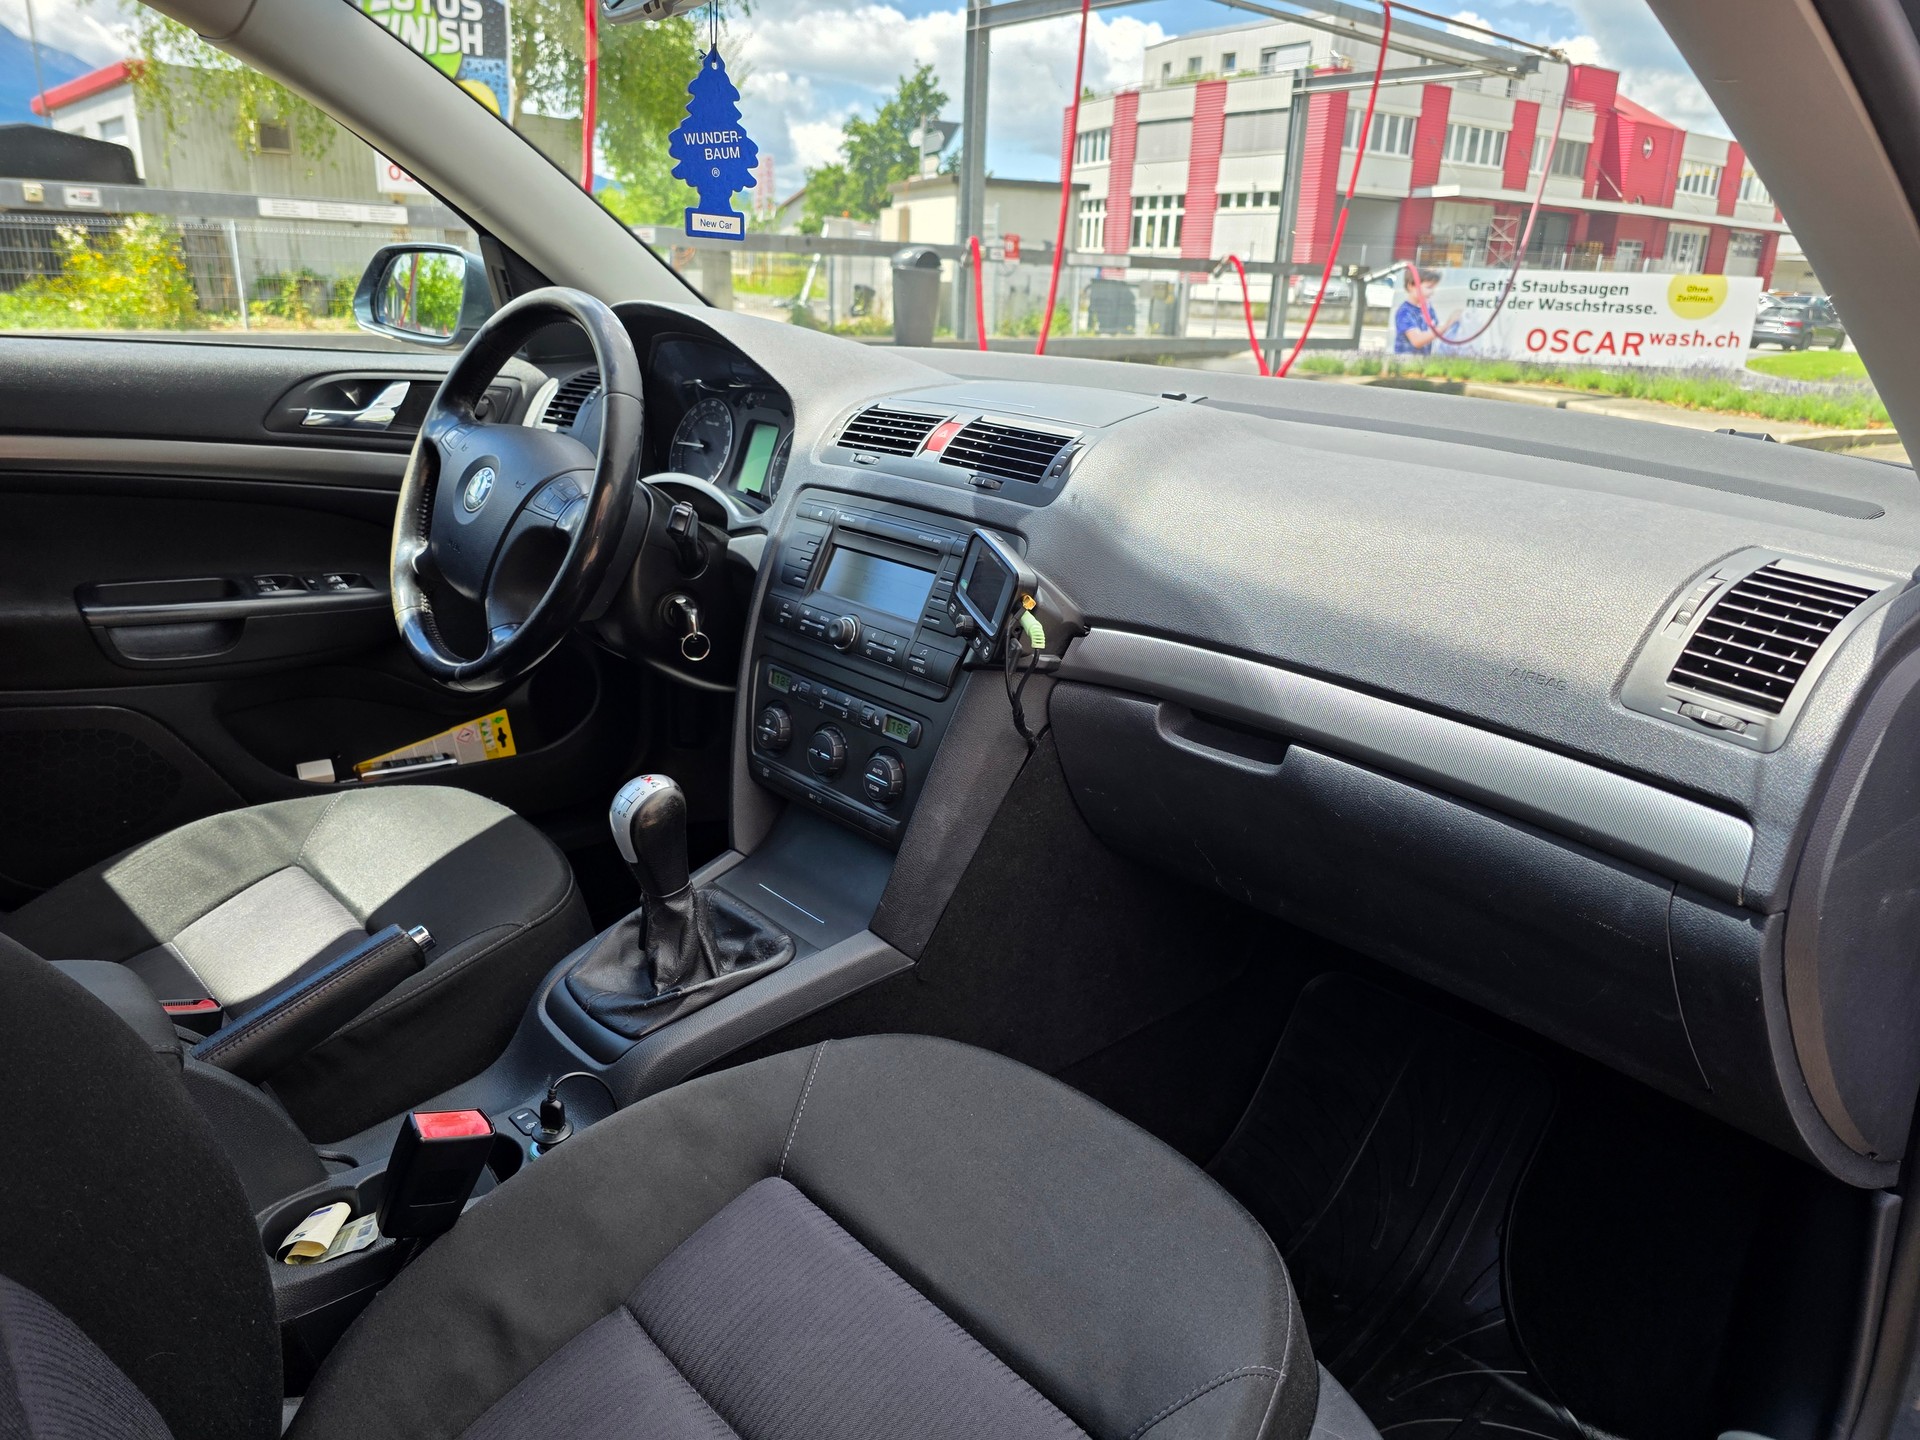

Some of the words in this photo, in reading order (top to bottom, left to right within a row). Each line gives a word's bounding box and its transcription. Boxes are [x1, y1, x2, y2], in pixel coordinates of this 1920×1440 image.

[683, 131, 742, 145] WUNDER-
[704, 147, 740, 160] BAUM
[699, 218, 717, 228] New
[718, 220, 732, 230] Car
[1521, 280, 1629, 298] Staubsaugen
[1466, 296, 1505, 309] nach
[1507, 297, 1533, 310] der
[1538, 298, 1658, 315] Waschstrasse.
